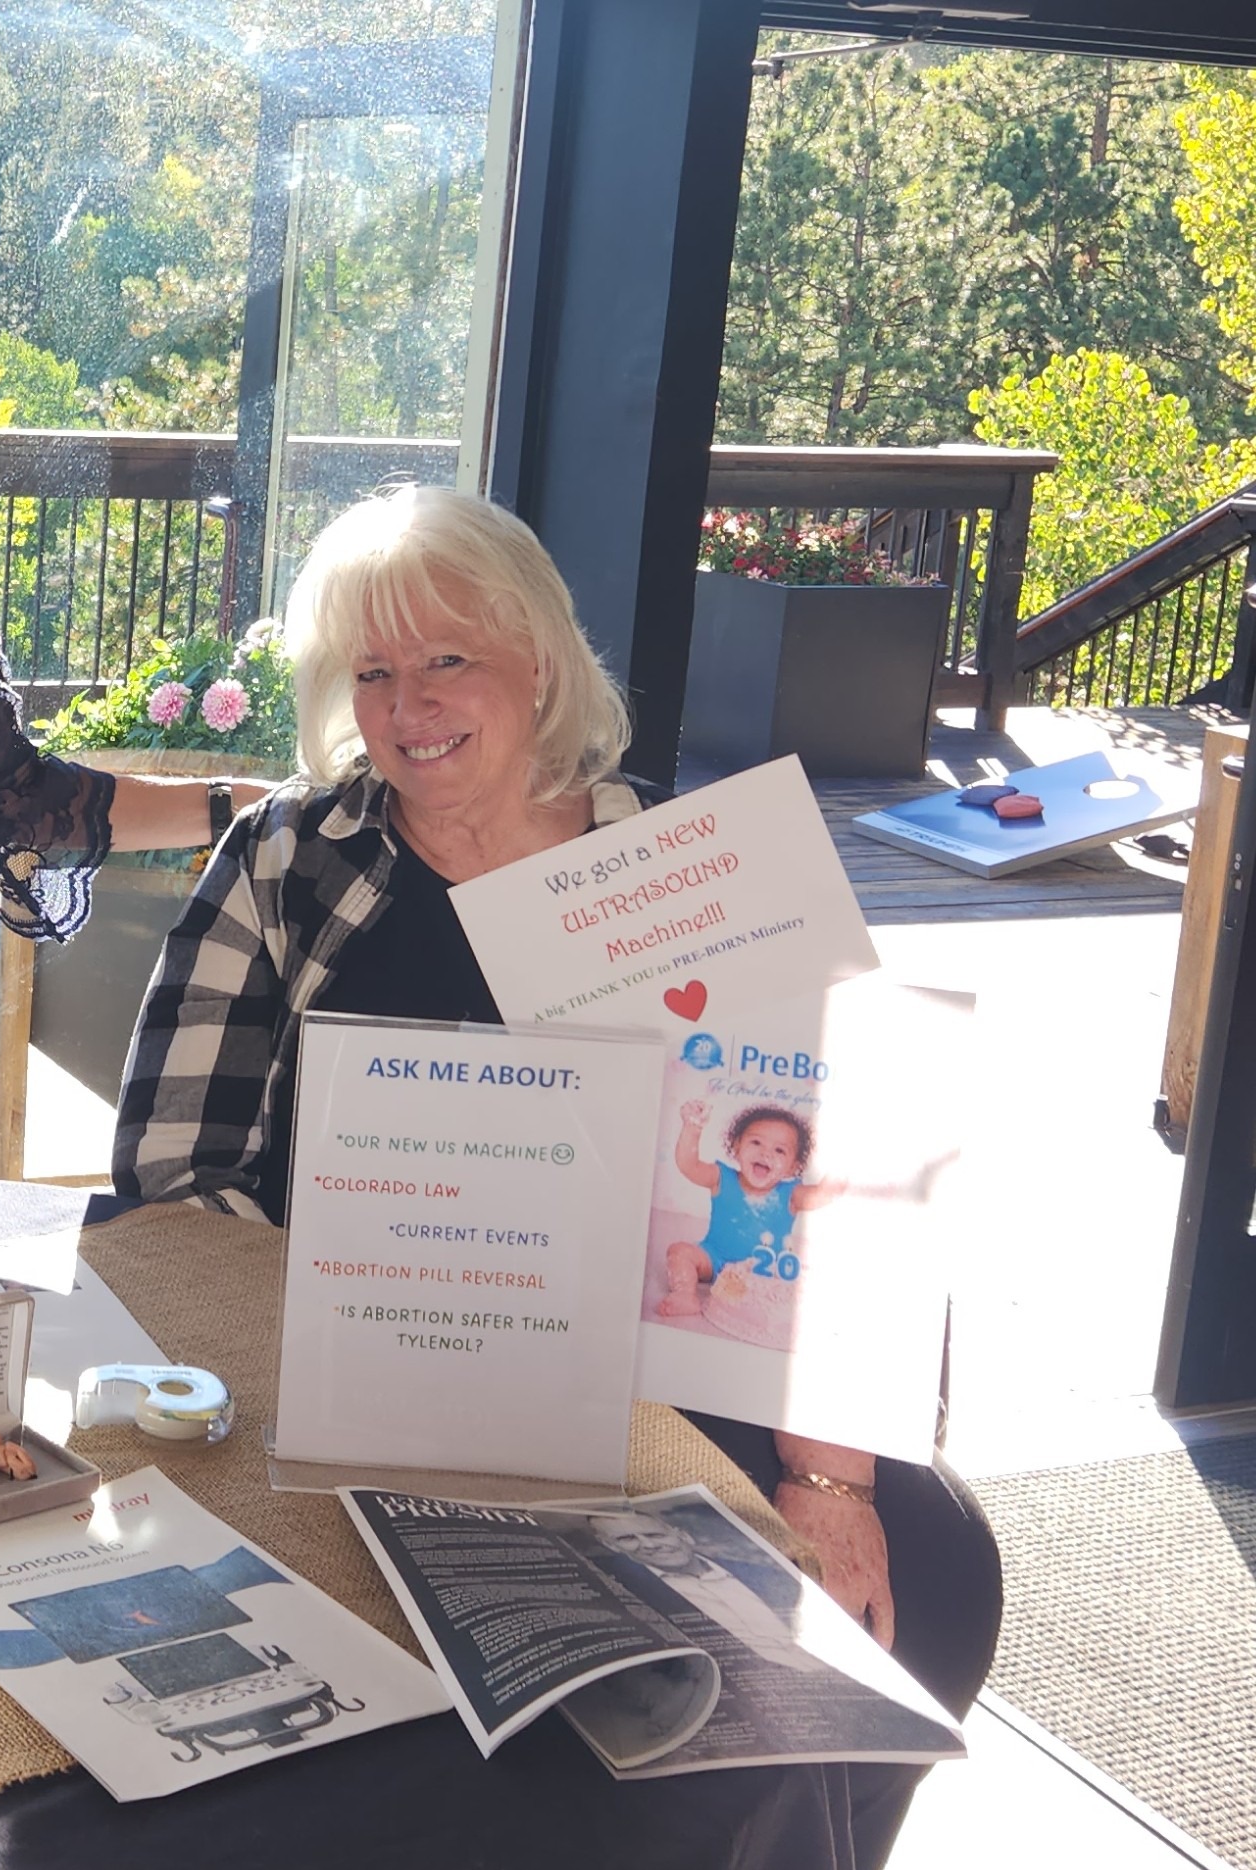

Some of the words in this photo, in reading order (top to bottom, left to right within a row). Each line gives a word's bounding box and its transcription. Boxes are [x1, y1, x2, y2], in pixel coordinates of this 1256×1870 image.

[544, 870, 587, 896] We
[591, 850, 630, 884] got
[636, 847, 652, 861] a
[655, 814, 715, 853] NEW
[561, 852, 739, 933] ULTRASOUND
[605, 901, 726, 963] Machine!!!
[533, 1011, 544, 1024] A
[545, 1004, 566, 1020] big
[566, 982, 620, 1010] THANK
[621, 967, 655, 988] YOU
[657, 962, 672, 975] to
[672, 934, 747, 969] PRE-BORN
[749, 916, 805, 943] Ministry
[366, 1057, 420, 1080] ASK
[429, 1061, 469, 1083] ME
[478, 1065, 581, 1090] ABOUT:
[388, 1138, 428, 1153] NEW
[435, 1141, 456, 1156] US
[463, 1143, 548, 1162] MACHINE
[425, 1183, 461, 1198] LAW
[486, 1229, 550, 1247] EVENTS
[419, 1267, 453, 1284] PILL
[462, 1271, 546, 1290] REVERSAL
[362, 1306, 453, 1326] ABORTION
[461, 1312, 514, 1330] SAFER
[521, 1317, 569, 1333] THAN
[397, 1333, 483, 1353] TYLENOL?
[88, 1540, 124, 1555] N6
[50, 1559, 109, 1576] Ultrasound
